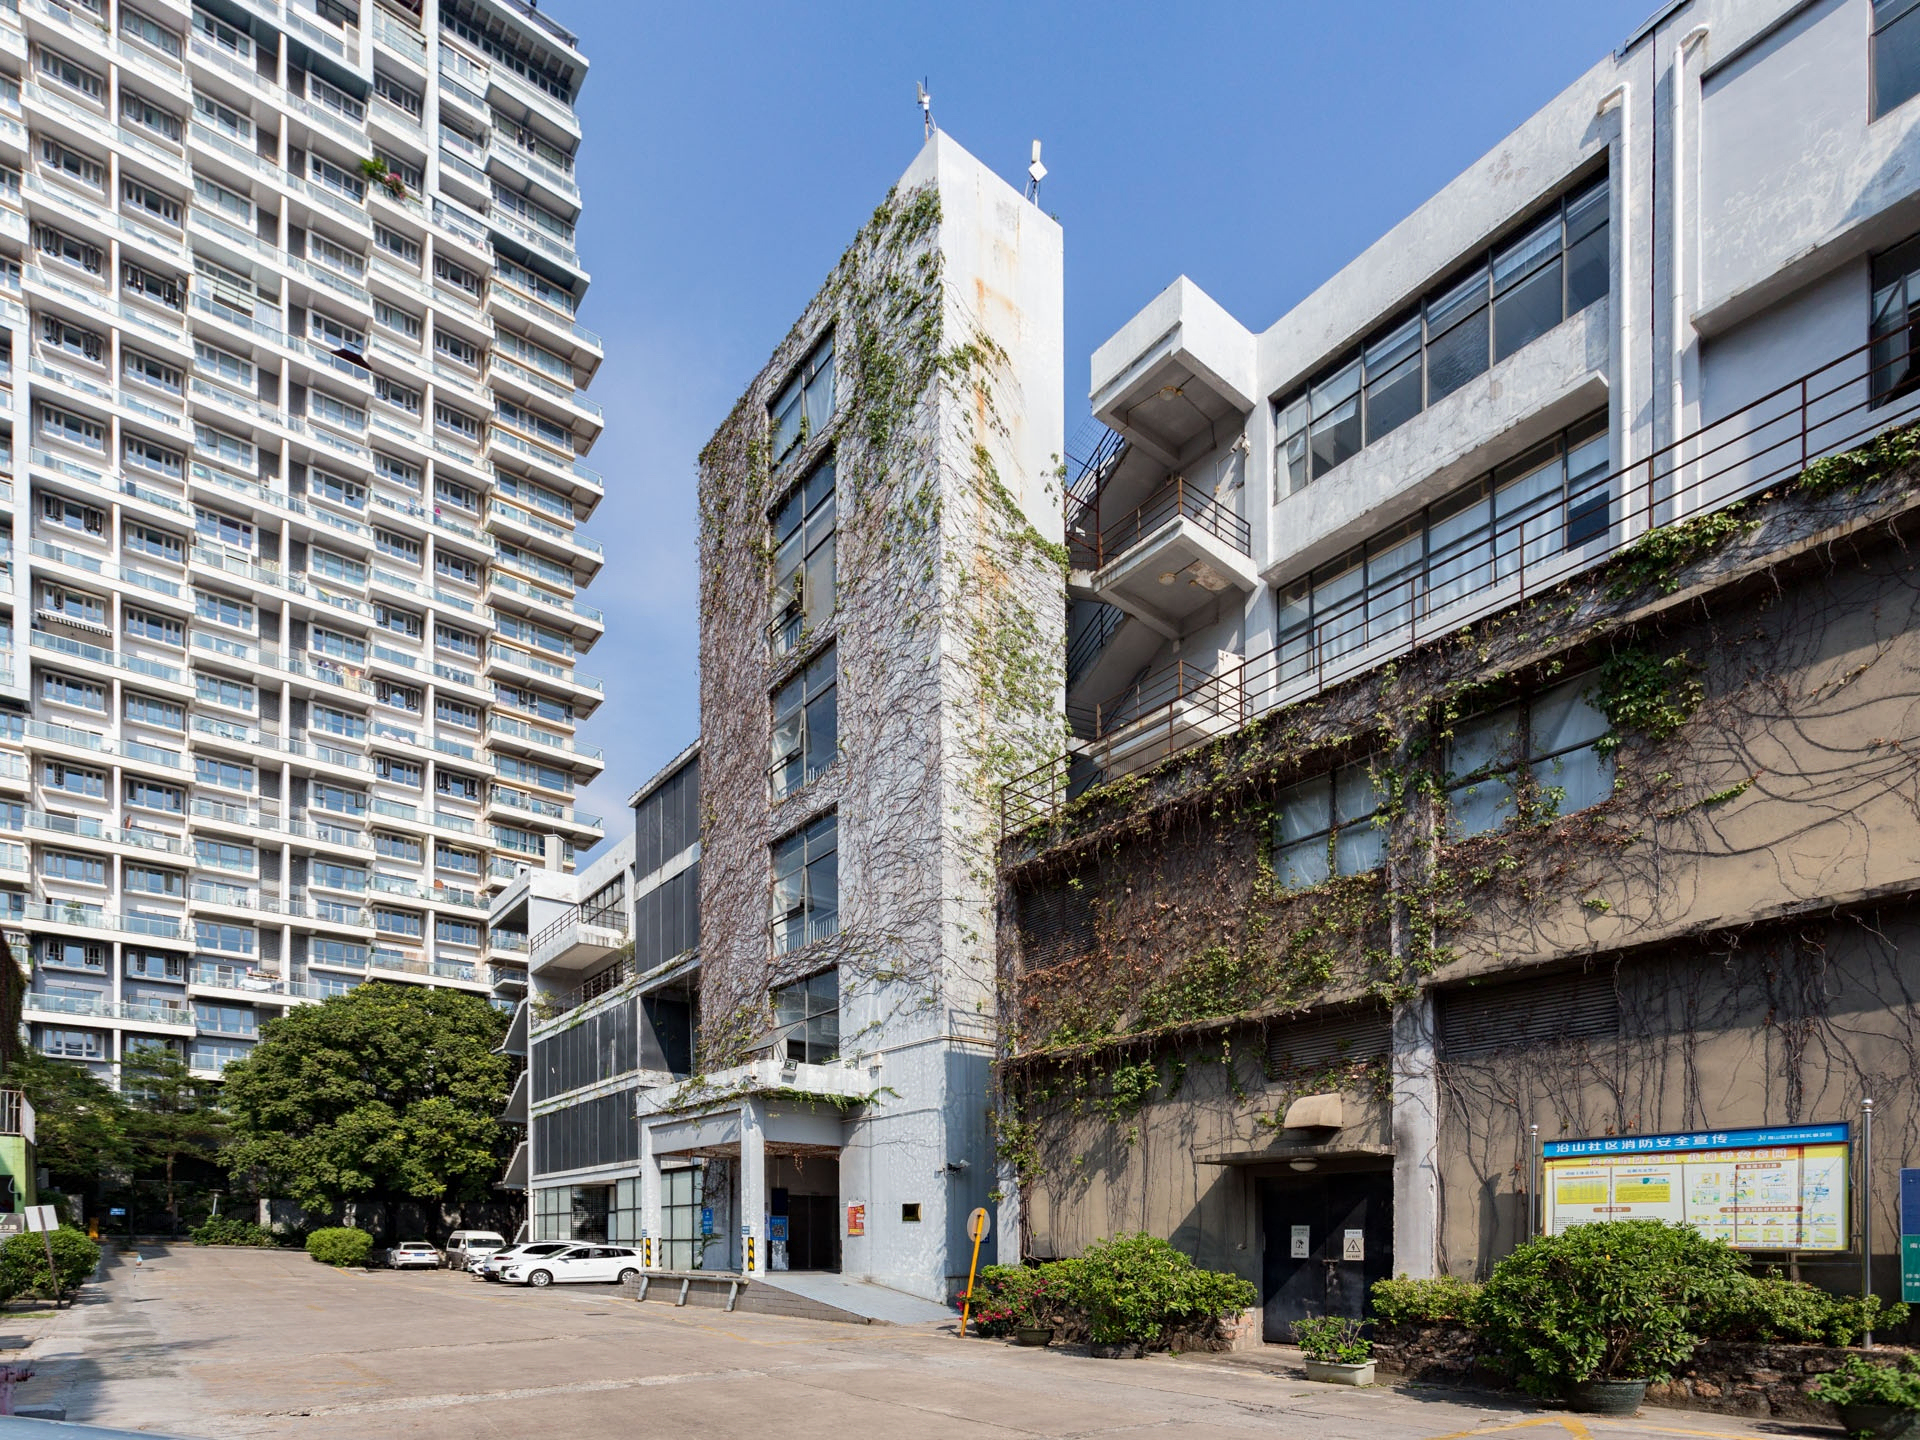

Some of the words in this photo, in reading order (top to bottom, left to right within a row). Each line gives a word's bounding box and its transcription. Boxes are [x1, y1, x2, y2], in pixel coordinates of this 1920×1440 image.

[1556, 1134, 1728, 1152] 沿山社区消防安全宣传
